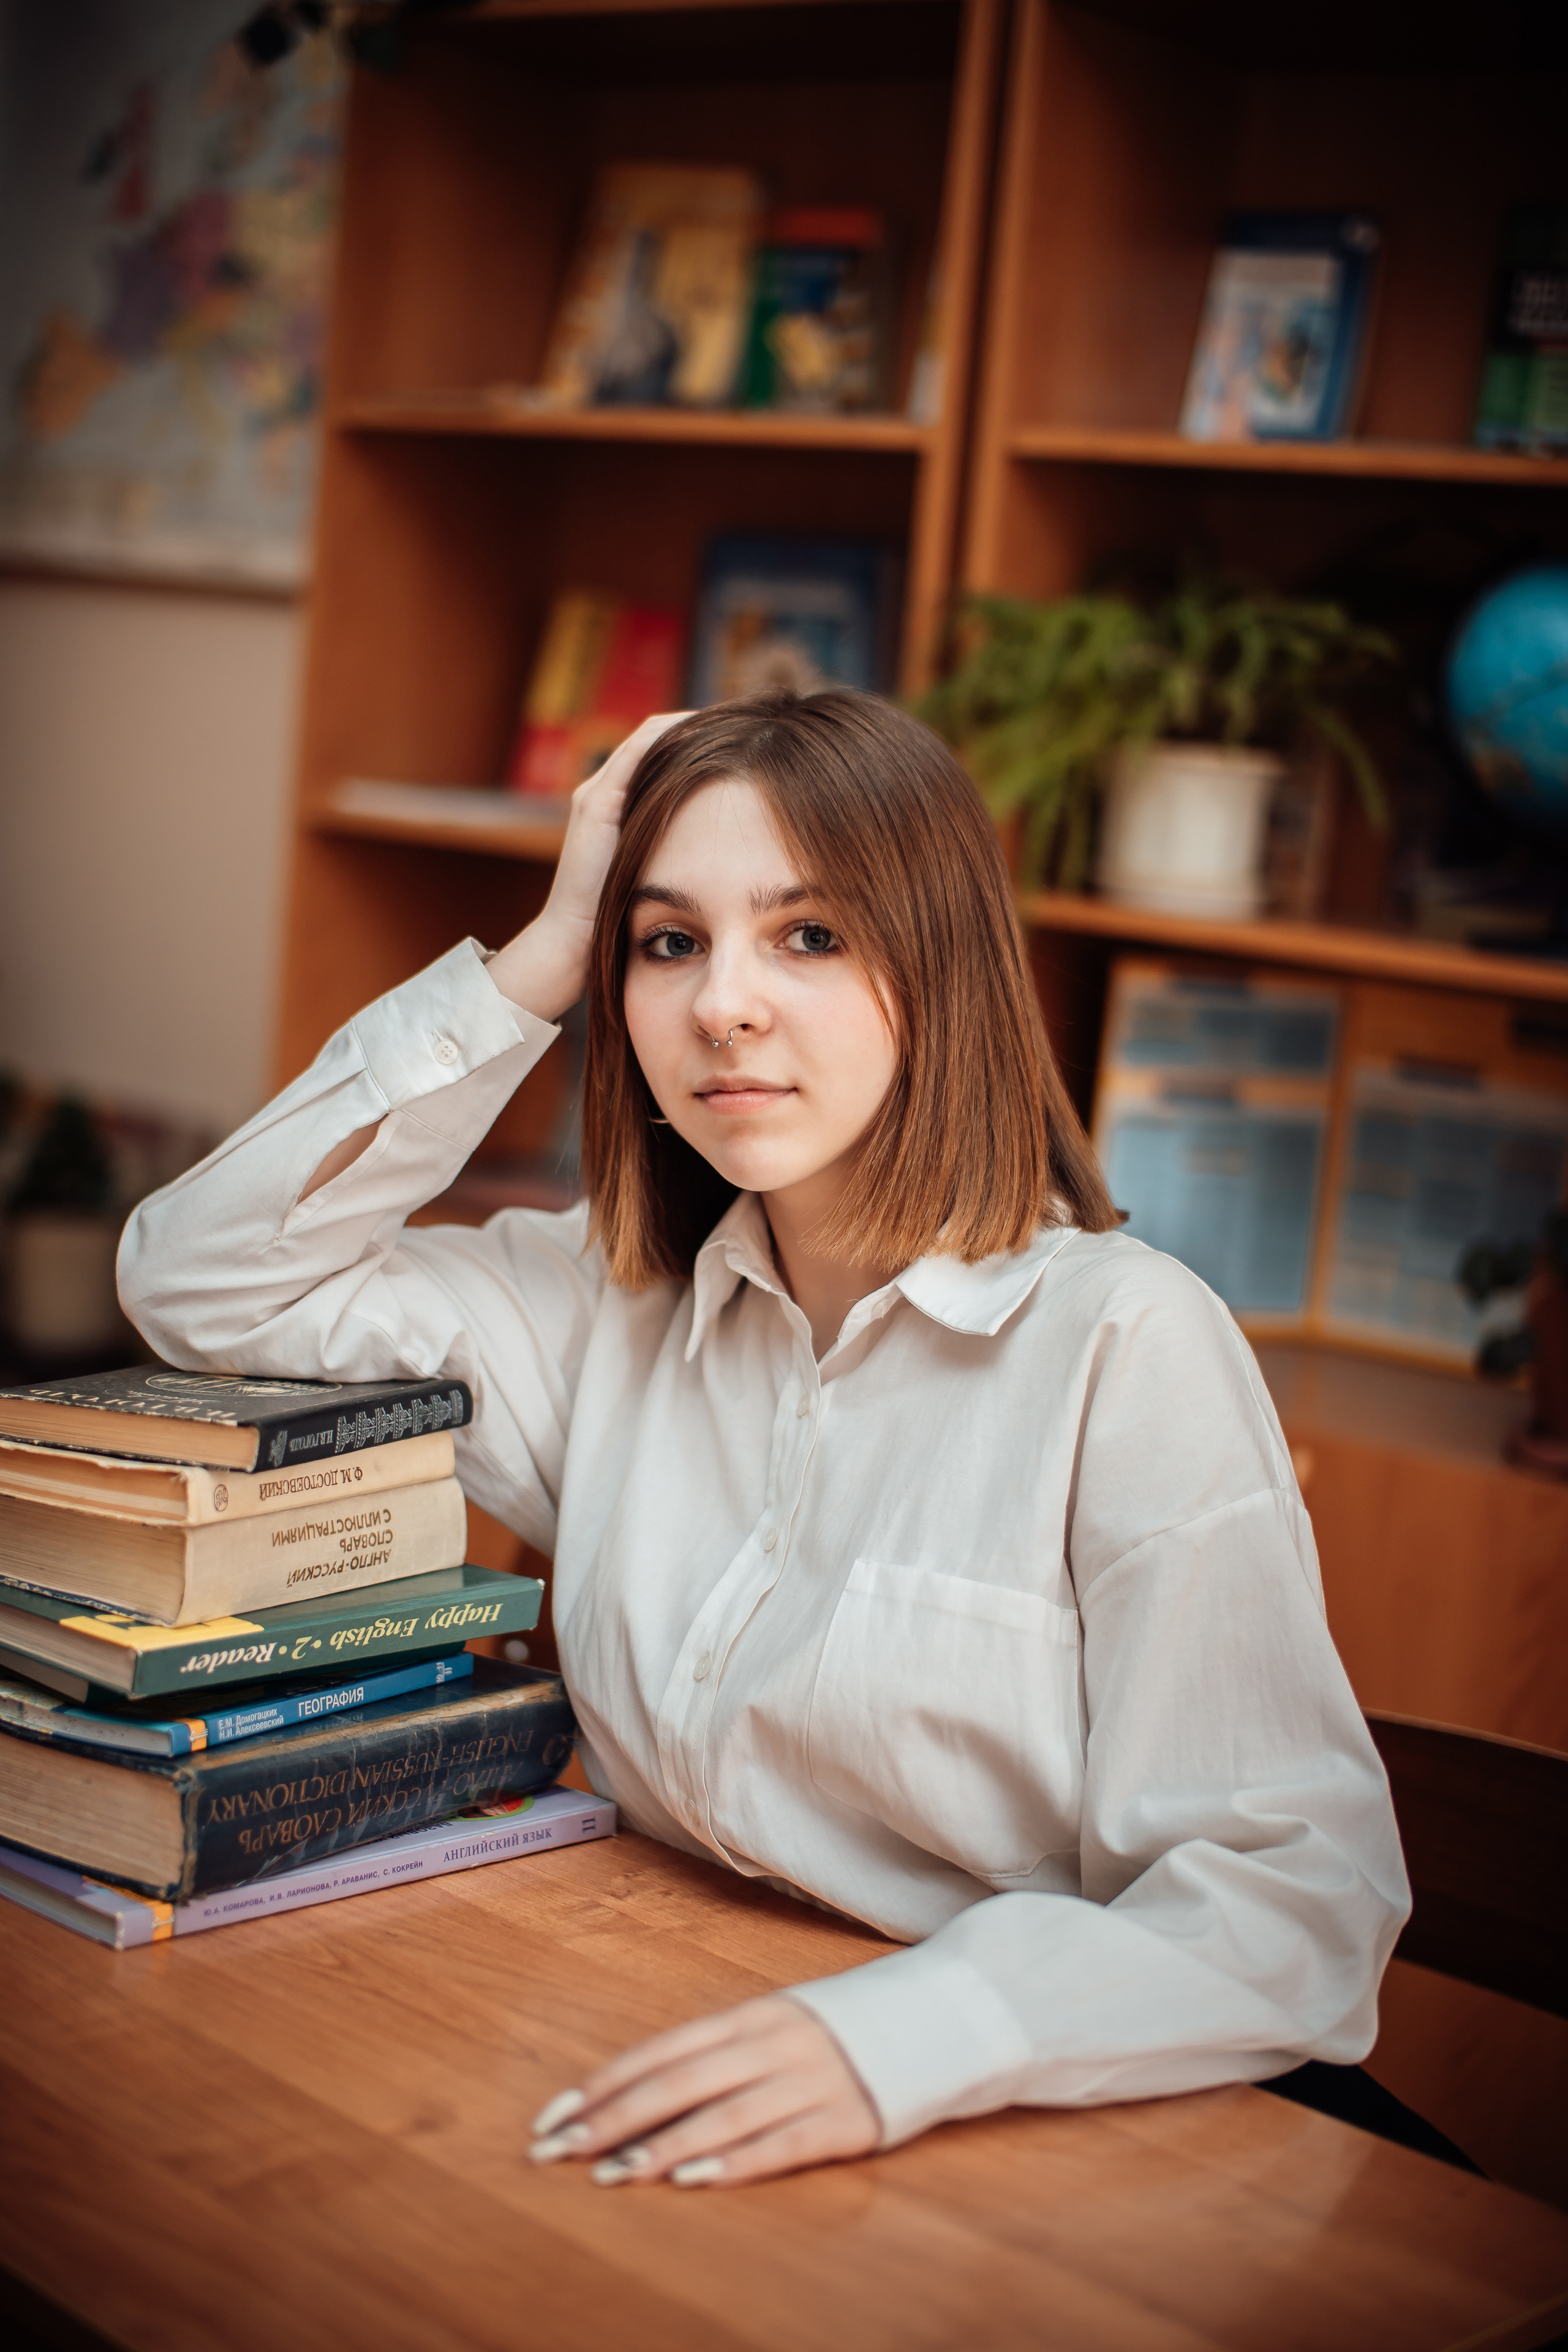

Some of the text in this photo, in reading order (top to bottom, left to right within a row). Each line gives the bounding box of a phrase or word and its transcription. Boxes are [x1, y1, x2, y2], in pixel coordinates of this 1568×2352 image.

[260, 1469, 339, 1501] ДОСТОЕВСКИЙ
[272, 1508, 392, 1547] С ИЛЛЮСТРАЦИЯМИ
[339, 1529, 394, 1553] СЛОВАРЬ
[287, 1549, 392, 1588] АНГЛО-РУССКИЙ
[179, 1603, 503, 1674] Happy English 2 Reader
[236, 1708, 278, 1727] Домогацких
[298, 1686, 364, 1717] ГЕОГРАФИЯ
[236, 1715, 284, 1736] Алексеевский
[207, 1770, 349, 1824] DICTIONARY
[238, 1807, 342, 1855] СЛОВАРЬ
[443, 1827, 552, 1863] АНГЛИЙСКИЙ ЯЗЫК
[223, 1896, 266, 1912] КОМАРОВА,
[286, 1882, 332, 1898] ЛАРИОНОВА,
[341, 1871, 380, 1887] АРАВАНИС,
[383, 1866, 390, 1875] С.
[391, 1860, 423, 1874] КОКРЕЙН
